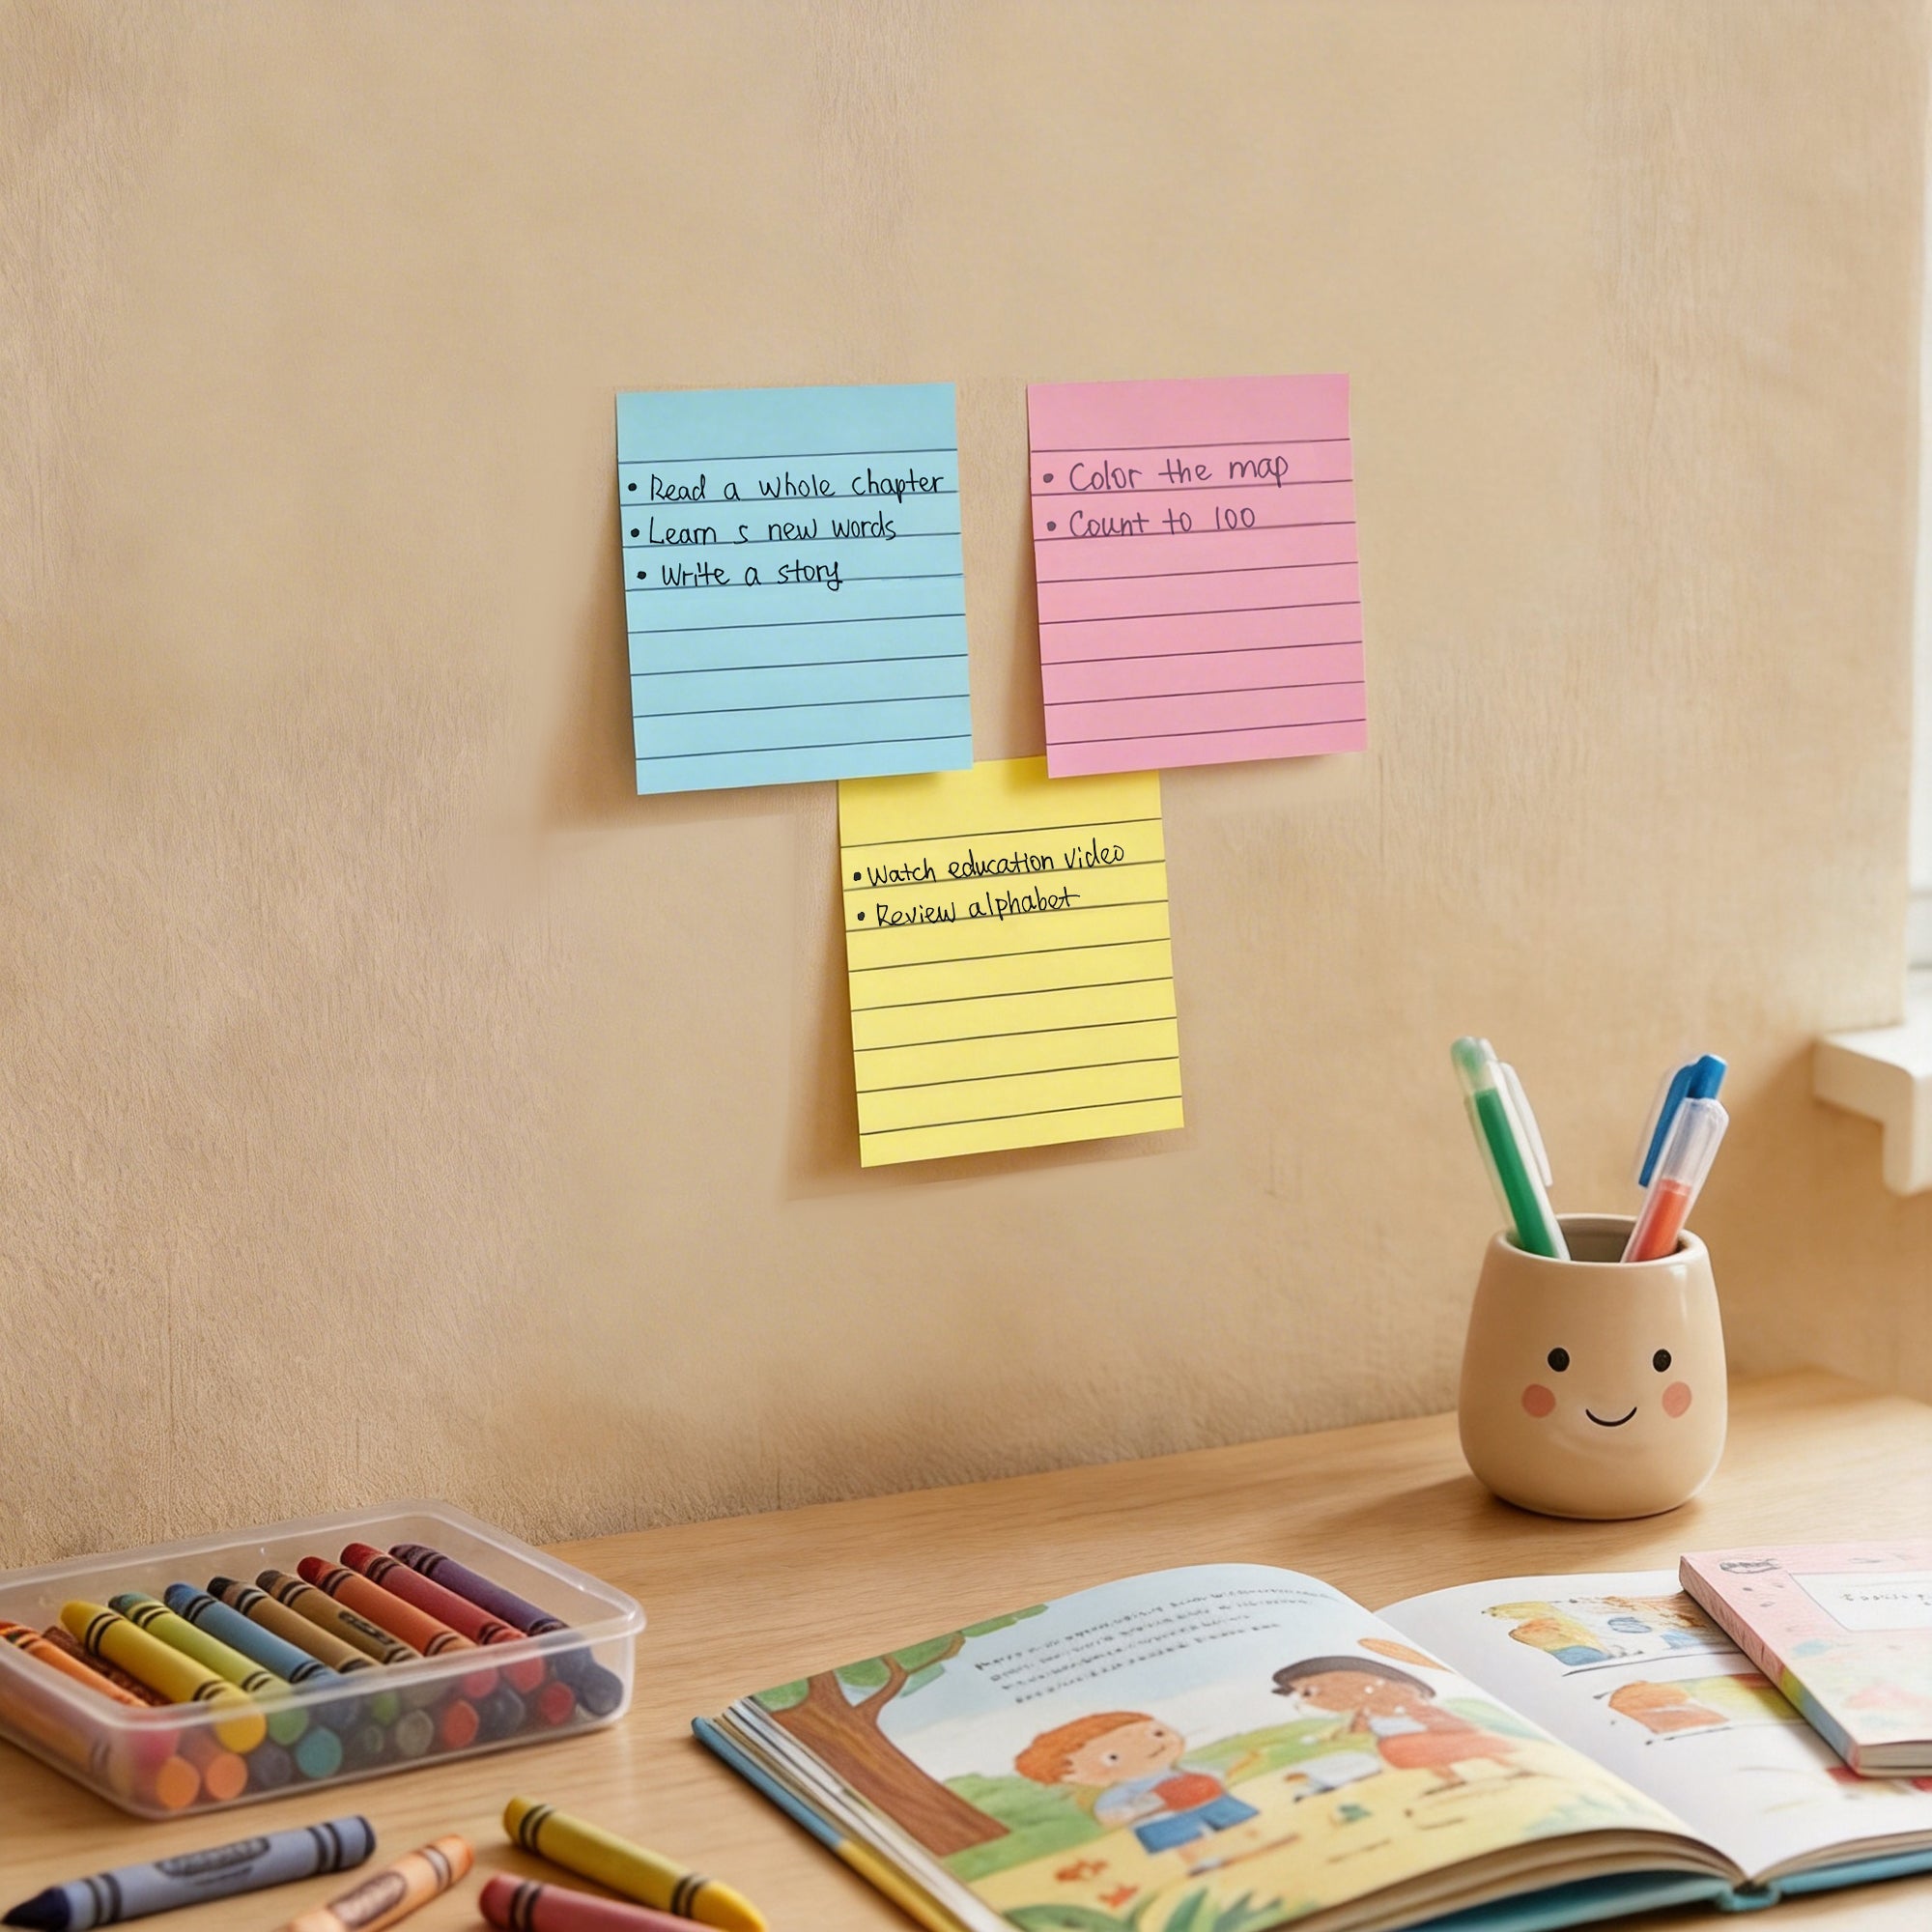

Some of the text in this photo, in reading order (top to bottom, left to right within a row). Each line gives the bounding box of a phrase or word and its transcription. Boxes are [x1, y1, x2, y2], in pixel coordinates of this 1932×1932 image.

[650, 473, 706, 501] Read
[724, 482, 740, 501] a
[851, 469, 944, 503] chapter
[1069, 456, 1289, 492] Color the map
[768, 519, 817, 541] new
[831, 511, 896, 540] words
[1069, 506, 1256, 537] Count to 100
[662, 559, 842, 591] Write a story
[867, 858, 936, 886] Watch
[948, 849, 1054, 878] education
[876, 886, 1080, 926] Review alphabet
